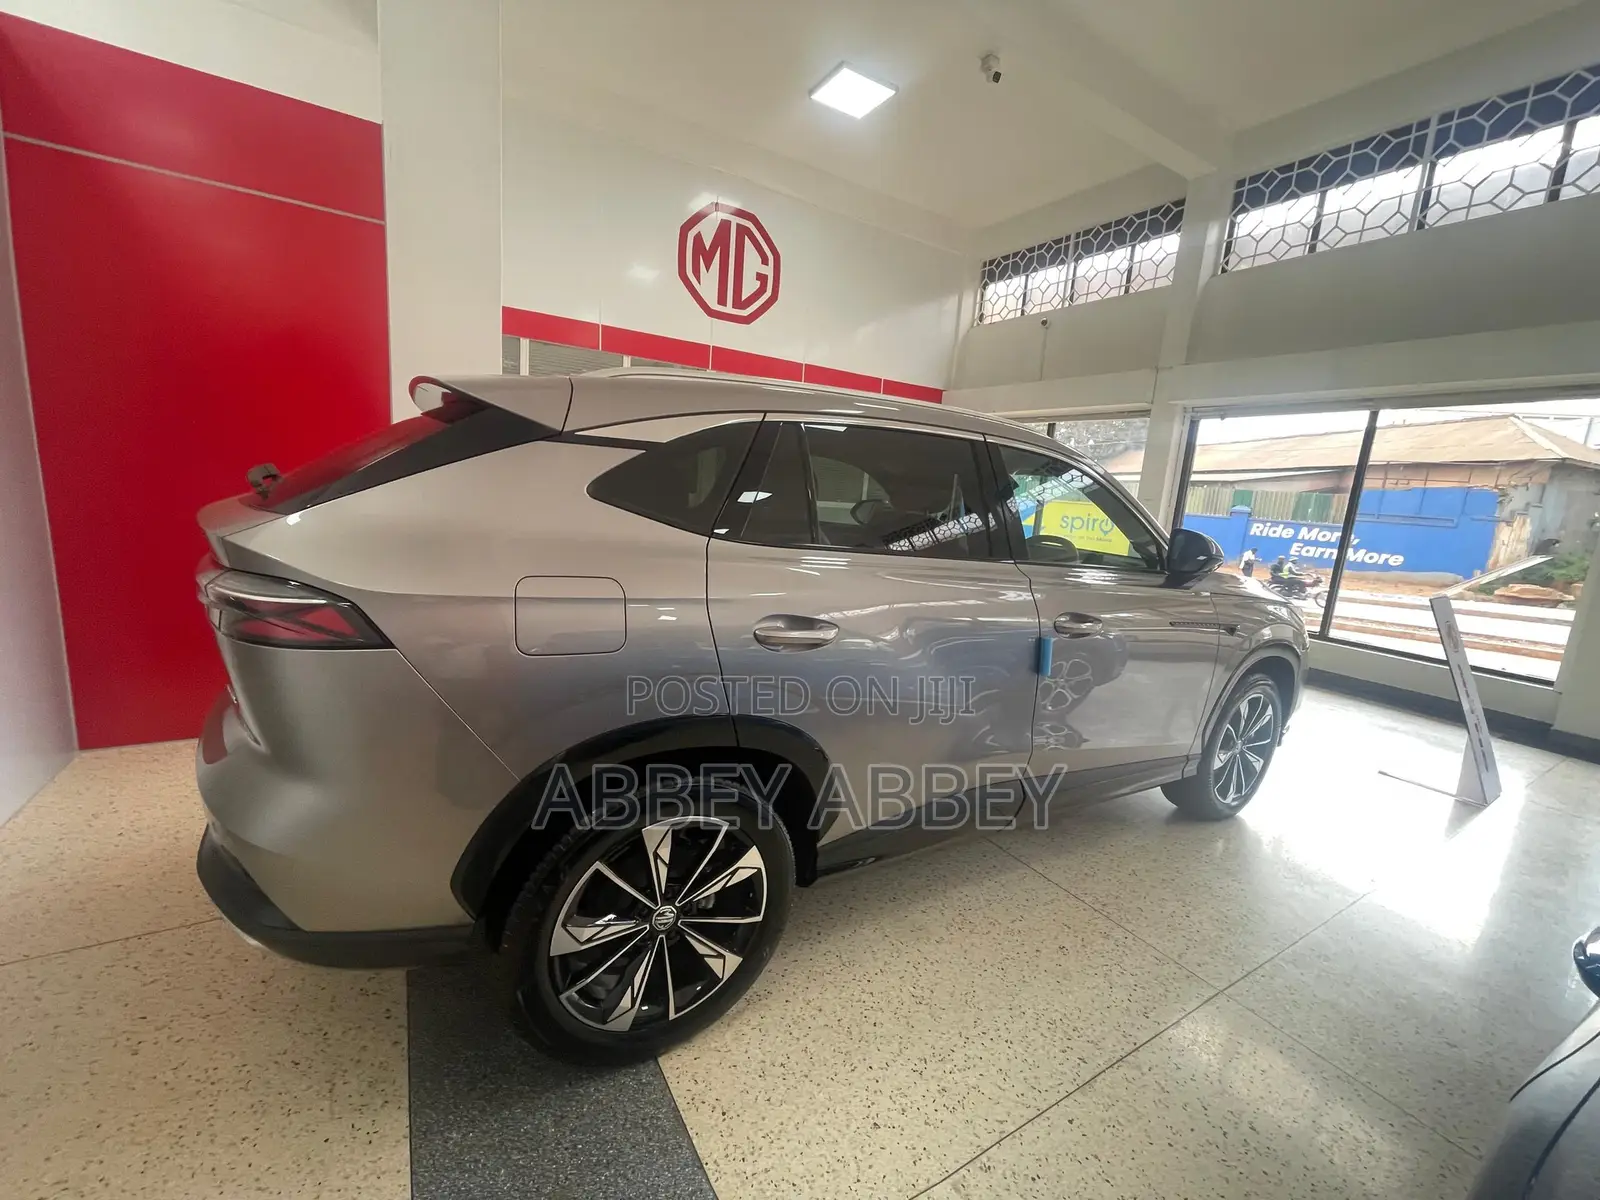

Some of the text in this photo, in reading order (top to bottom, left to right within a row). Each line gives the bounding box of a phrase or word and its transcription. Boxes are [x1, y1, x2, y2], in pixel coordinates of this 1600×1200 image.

[691, 217, 770, 311] MG
[1250, 522, 1295, 539] Ride
[1289, 542, 1405, 567] Earn More
